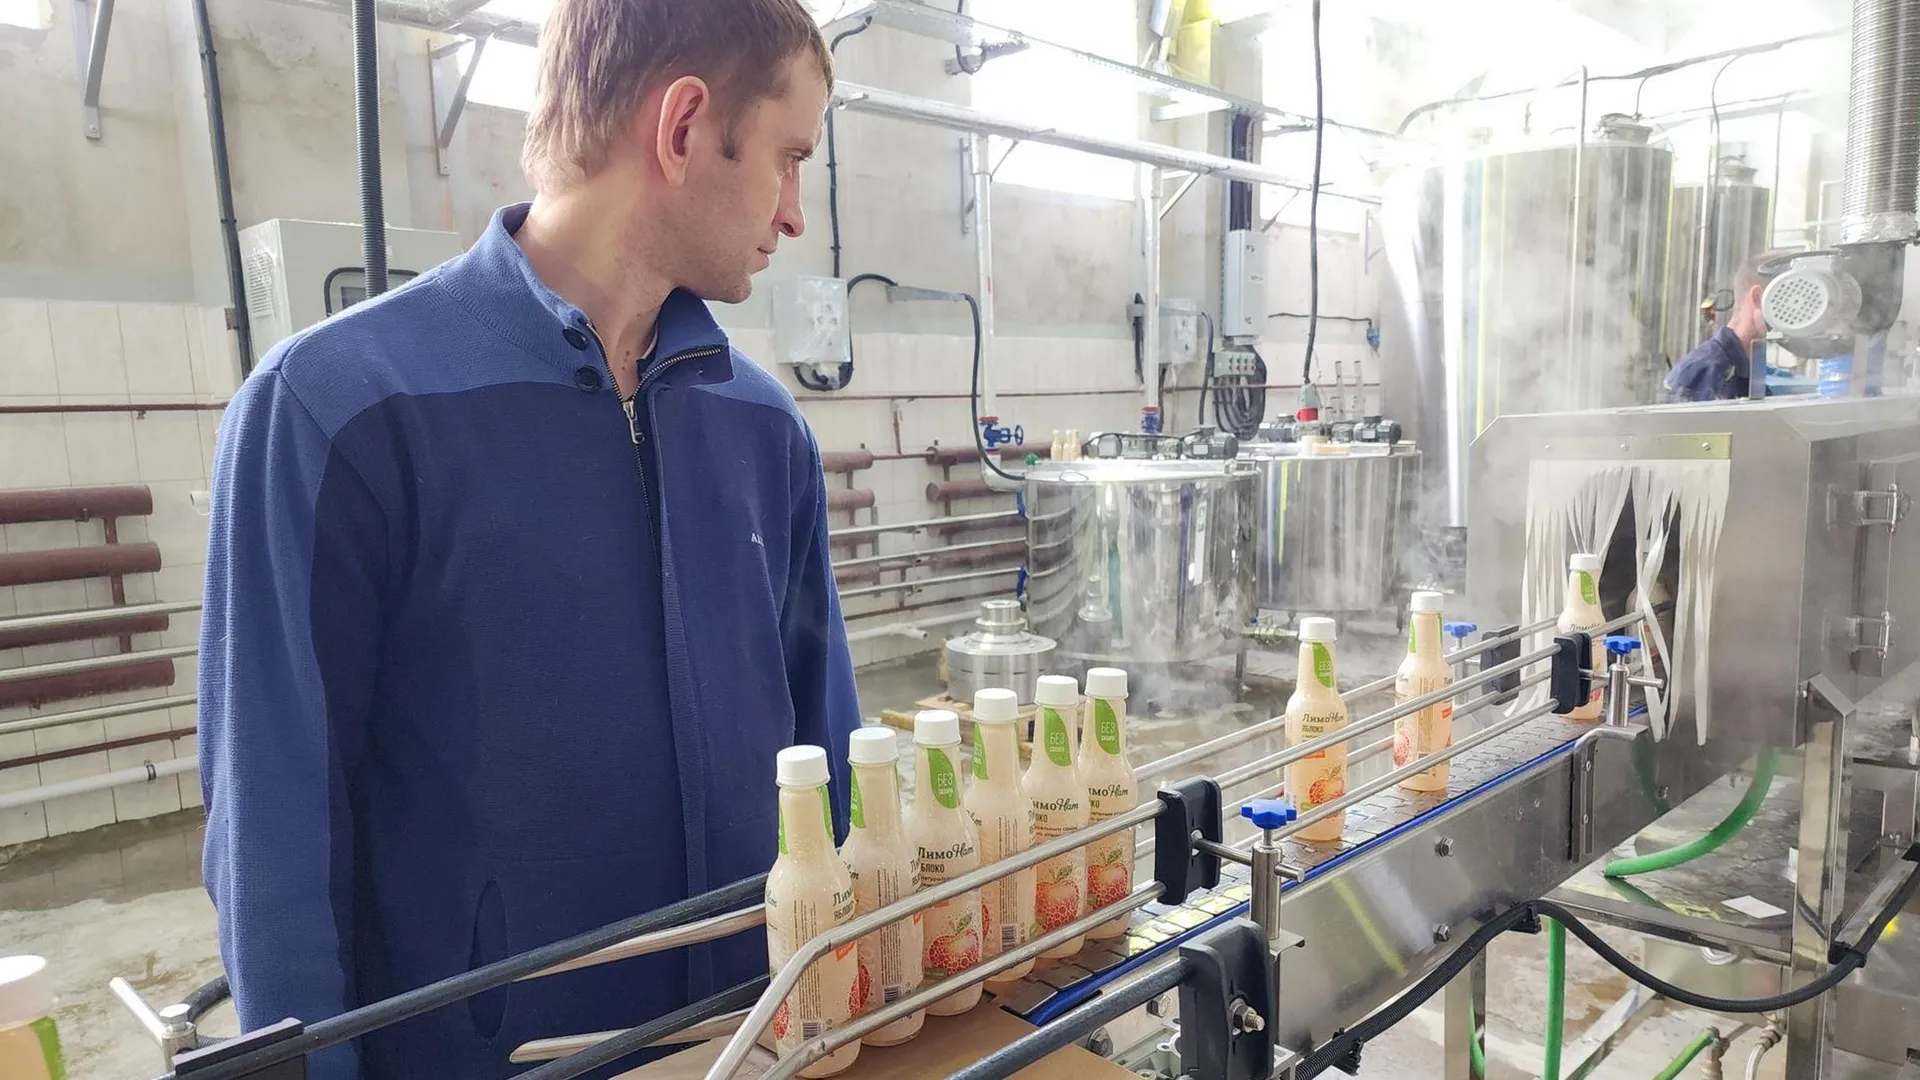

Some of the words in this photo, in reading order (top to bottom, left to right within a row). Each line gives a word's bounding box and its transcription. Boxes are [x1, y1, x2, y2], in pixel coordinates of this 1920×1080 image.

[1101, 721, 1117, 734] БЕЗ
[1050, 732, 1065, 745] БЕЗ
[938, 772, 953, 787] БЕЗ
[1032, 797, 1079, 812] имоНат
[920, 863, 945, 873] БЛОКО
